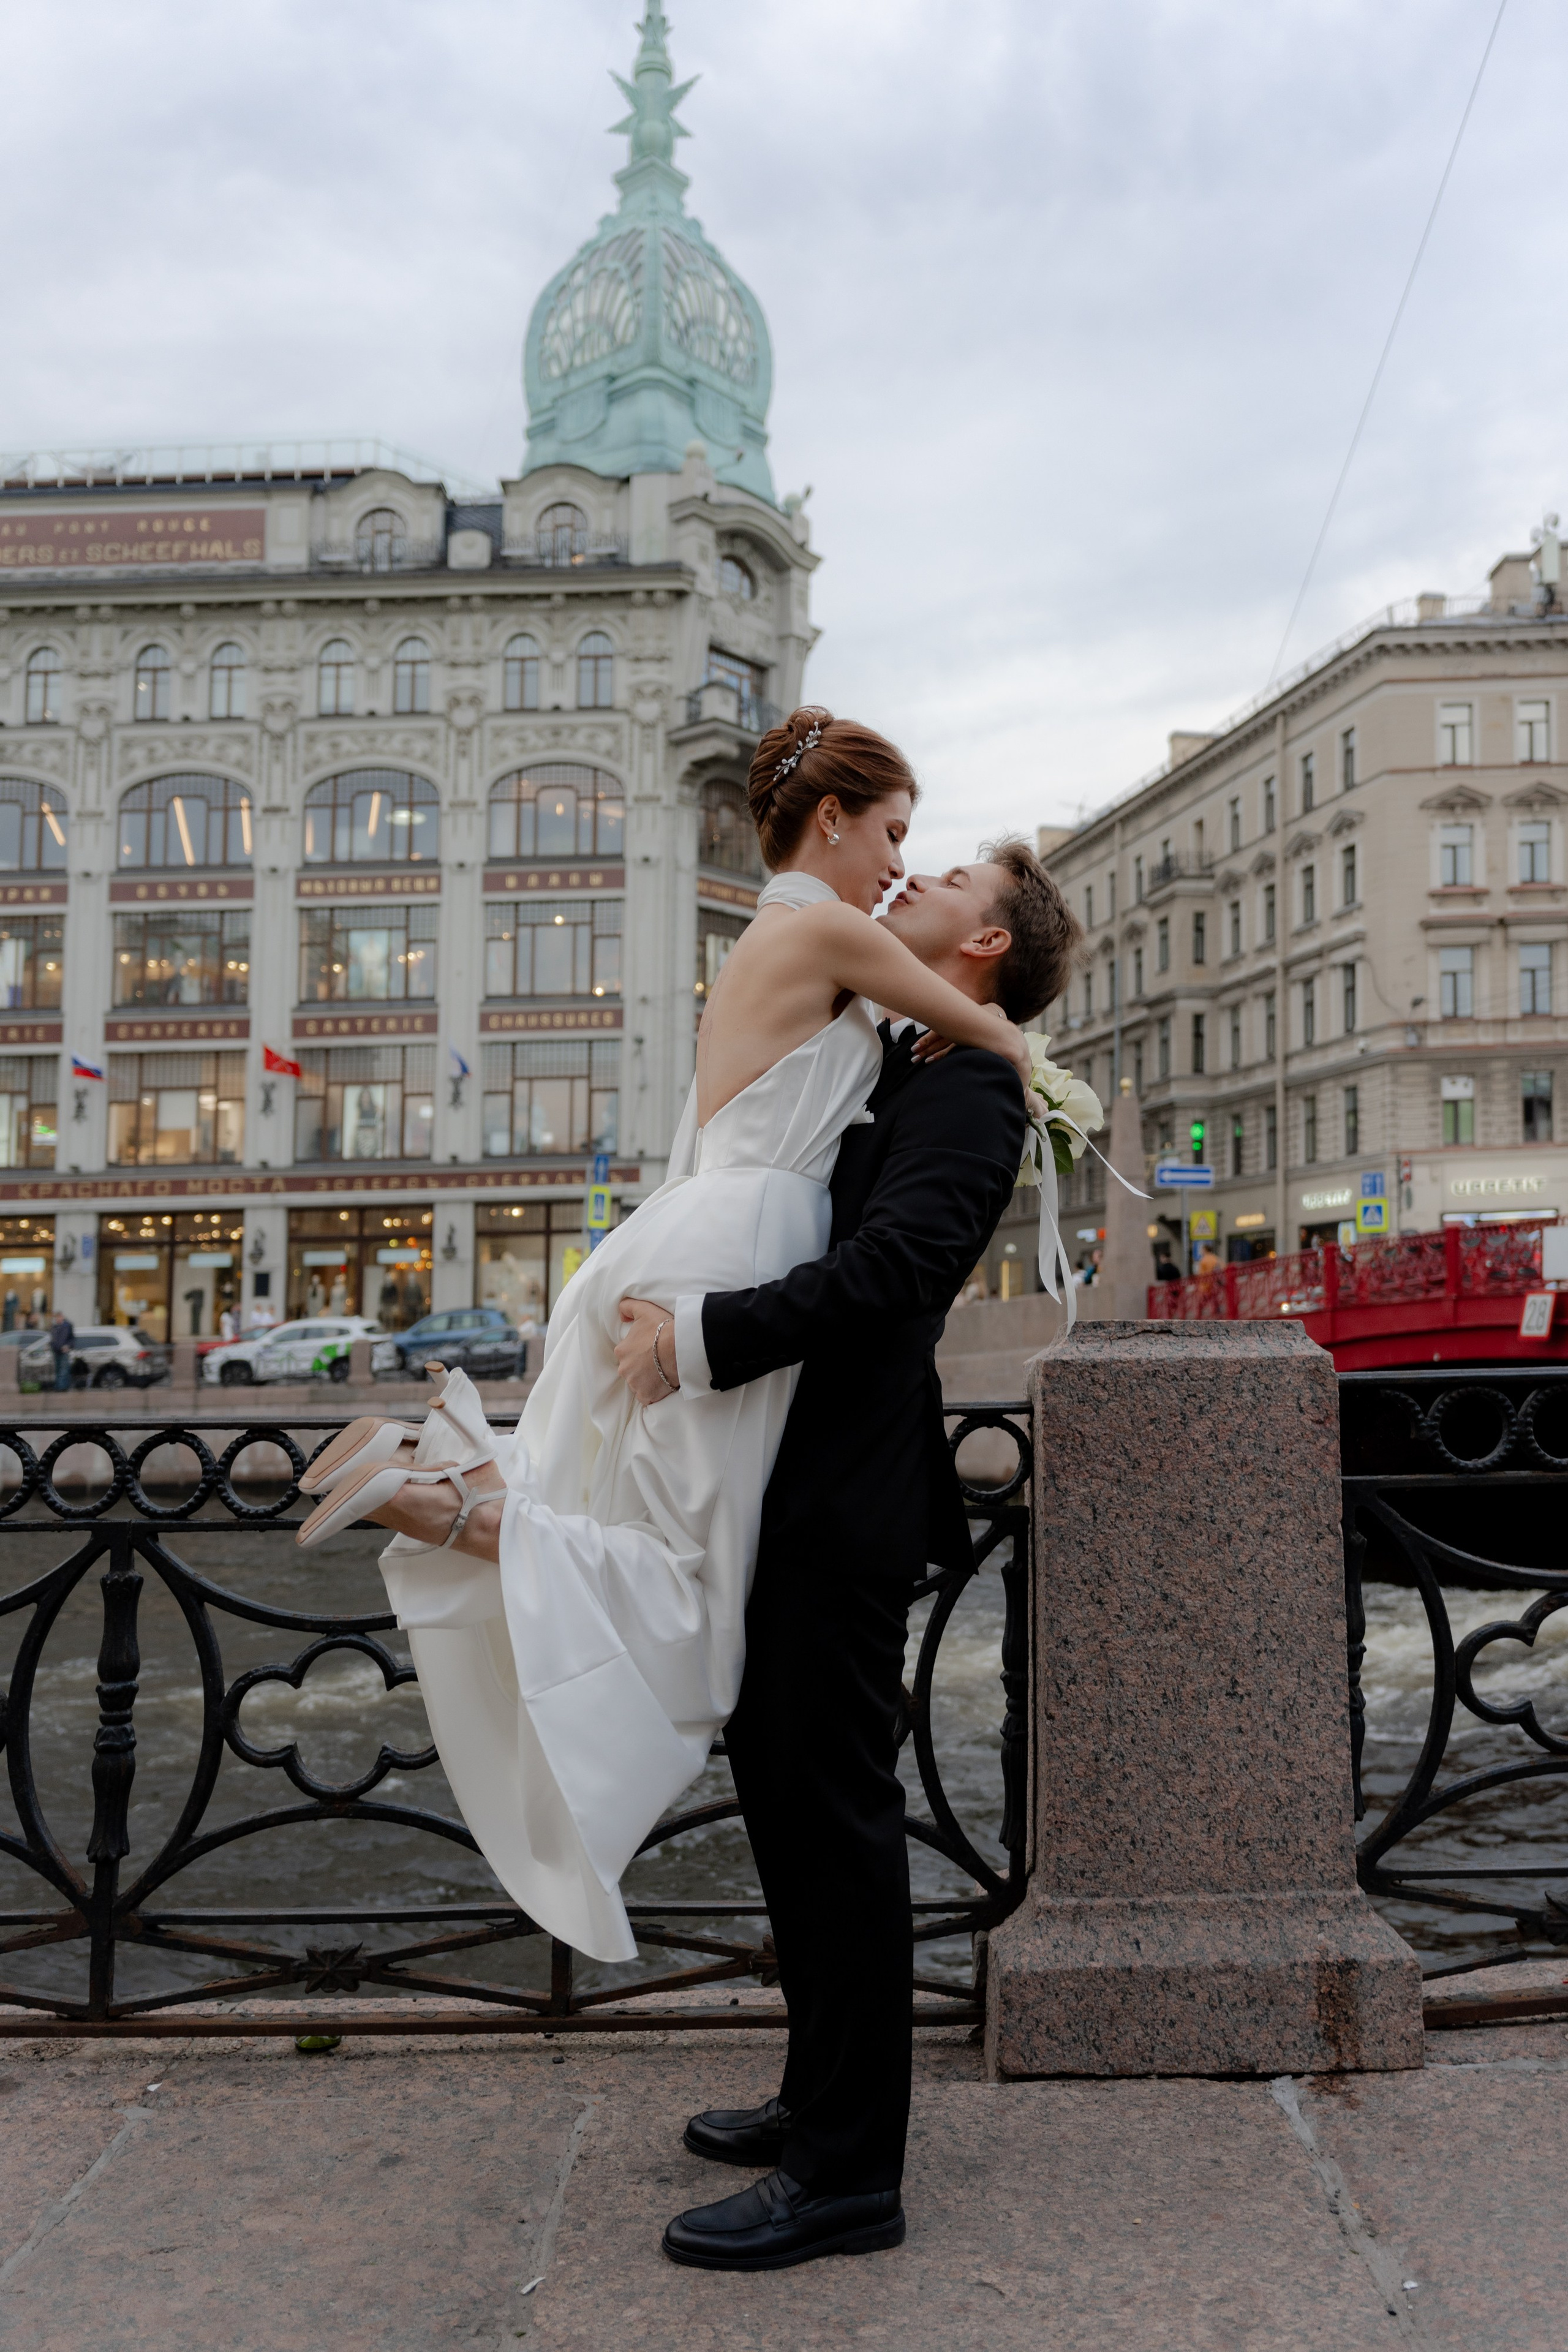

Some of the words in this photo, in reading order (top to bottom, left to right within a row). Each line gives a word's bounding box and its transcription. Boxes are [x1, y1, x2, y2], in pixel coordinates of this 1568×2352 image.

[0, 544, 53, 565] ERS
[86, 538, 262, 562] SCHEEFHALS
[489, 1012, 614, 1029] CHAUSSURES
[117, 1022, 238, 1039] CHAPEAUX
[18, 1180, 172, 1199] КРАСНАГО
[186, 1177, 287, 1195] МОСТА
